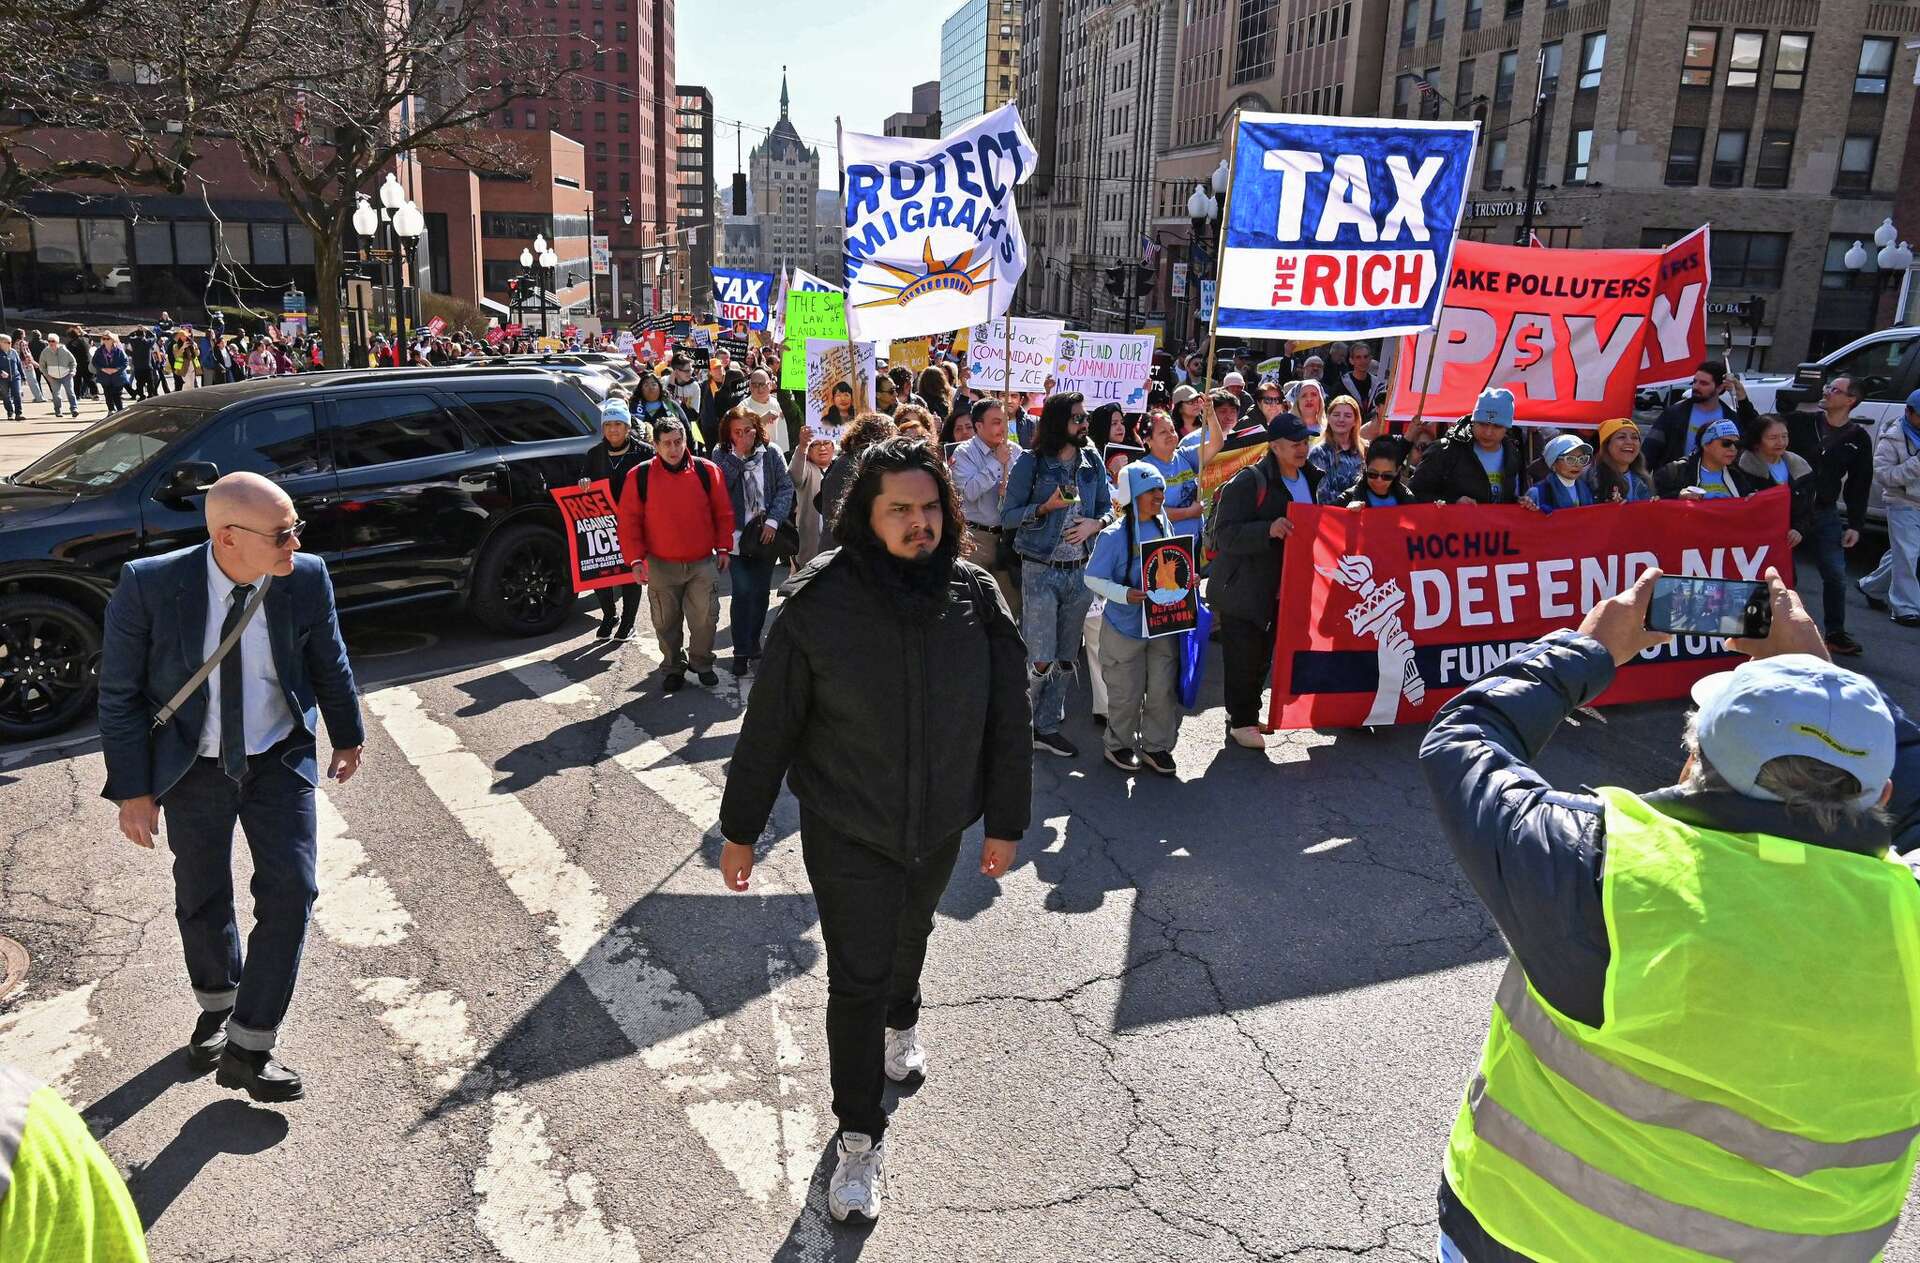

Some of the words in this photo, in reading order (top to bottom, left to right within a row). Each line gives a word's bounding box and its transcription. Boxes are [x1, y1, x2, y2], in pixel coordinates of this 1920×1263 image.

[844, 131, 1024, 228] ROTECT
[1263, 150, 1445, 242] TAX
[1475, 202, 1514, 216] TRUSTCO
[1516, 201, 1544, 215] BK
[843, 197, 1015, 285] MIGRANTS
[713, 276, 763, 305] TAX
[1271, 256, 1297, 306] THE
[1300, 254, 1424, 306] RICH
[1506, 272, 1652, 299] POLLUTERS
[722, 304, 758, 321] RICH
[791, 295, 817, 312] THE
[1727, 303, 1741, 313] BA
[803, 314, 823, 325] LAW
[994, 322, 1016, 341] Fud
[1019, 334, 1036, 345] our
[1079, 338, 1113, 359] FUND
[1120, 340, 1143, 362] OUR
[1410, 305, 1646, 402] PAY
[1020, 369, 1042, 384] ICE
[1068, 358, 1148, 380] COMMUNITIES
[1092, 381, 1122, 400] ICE
[562, 492, 613, 519] RISE
[576, 514, 619, 534] AGAINST
[586, 527, 621, 557] ICE
[1406, 531, 1520, 560] HOCHUL
[1681, 545, 1770, 581] NY
[1150, 615, 1169, 627] NEW
[1171, 609, 1194, 623] YORK
